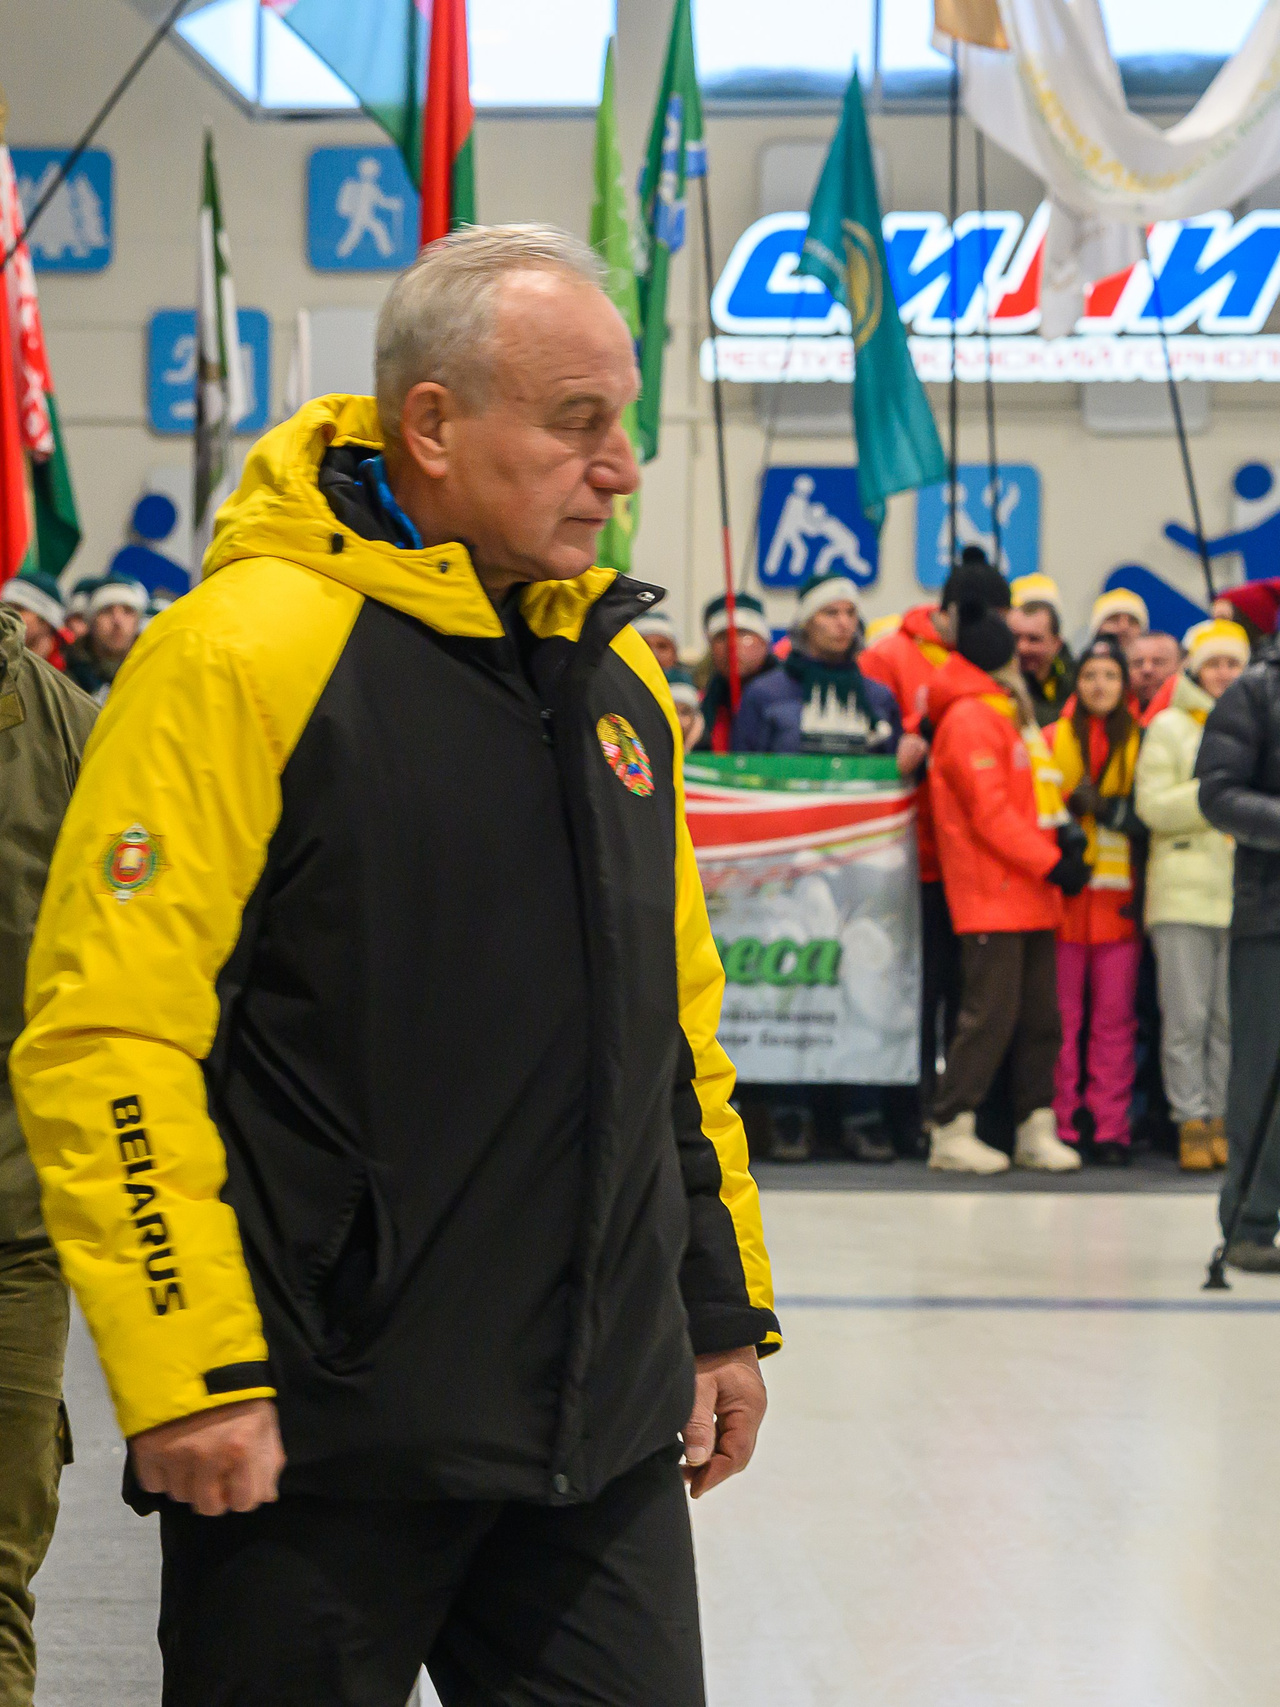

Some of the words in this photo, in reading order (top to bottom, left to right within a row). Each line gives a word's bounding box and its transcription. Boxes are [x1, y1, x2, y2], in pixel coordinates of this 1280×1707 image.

[717, 349, 1110, 368] РЕСПУБКАНСКИЙ
[715, 937, 842, 987] еса
[111, 1094, 187, 1316] BELARUS
